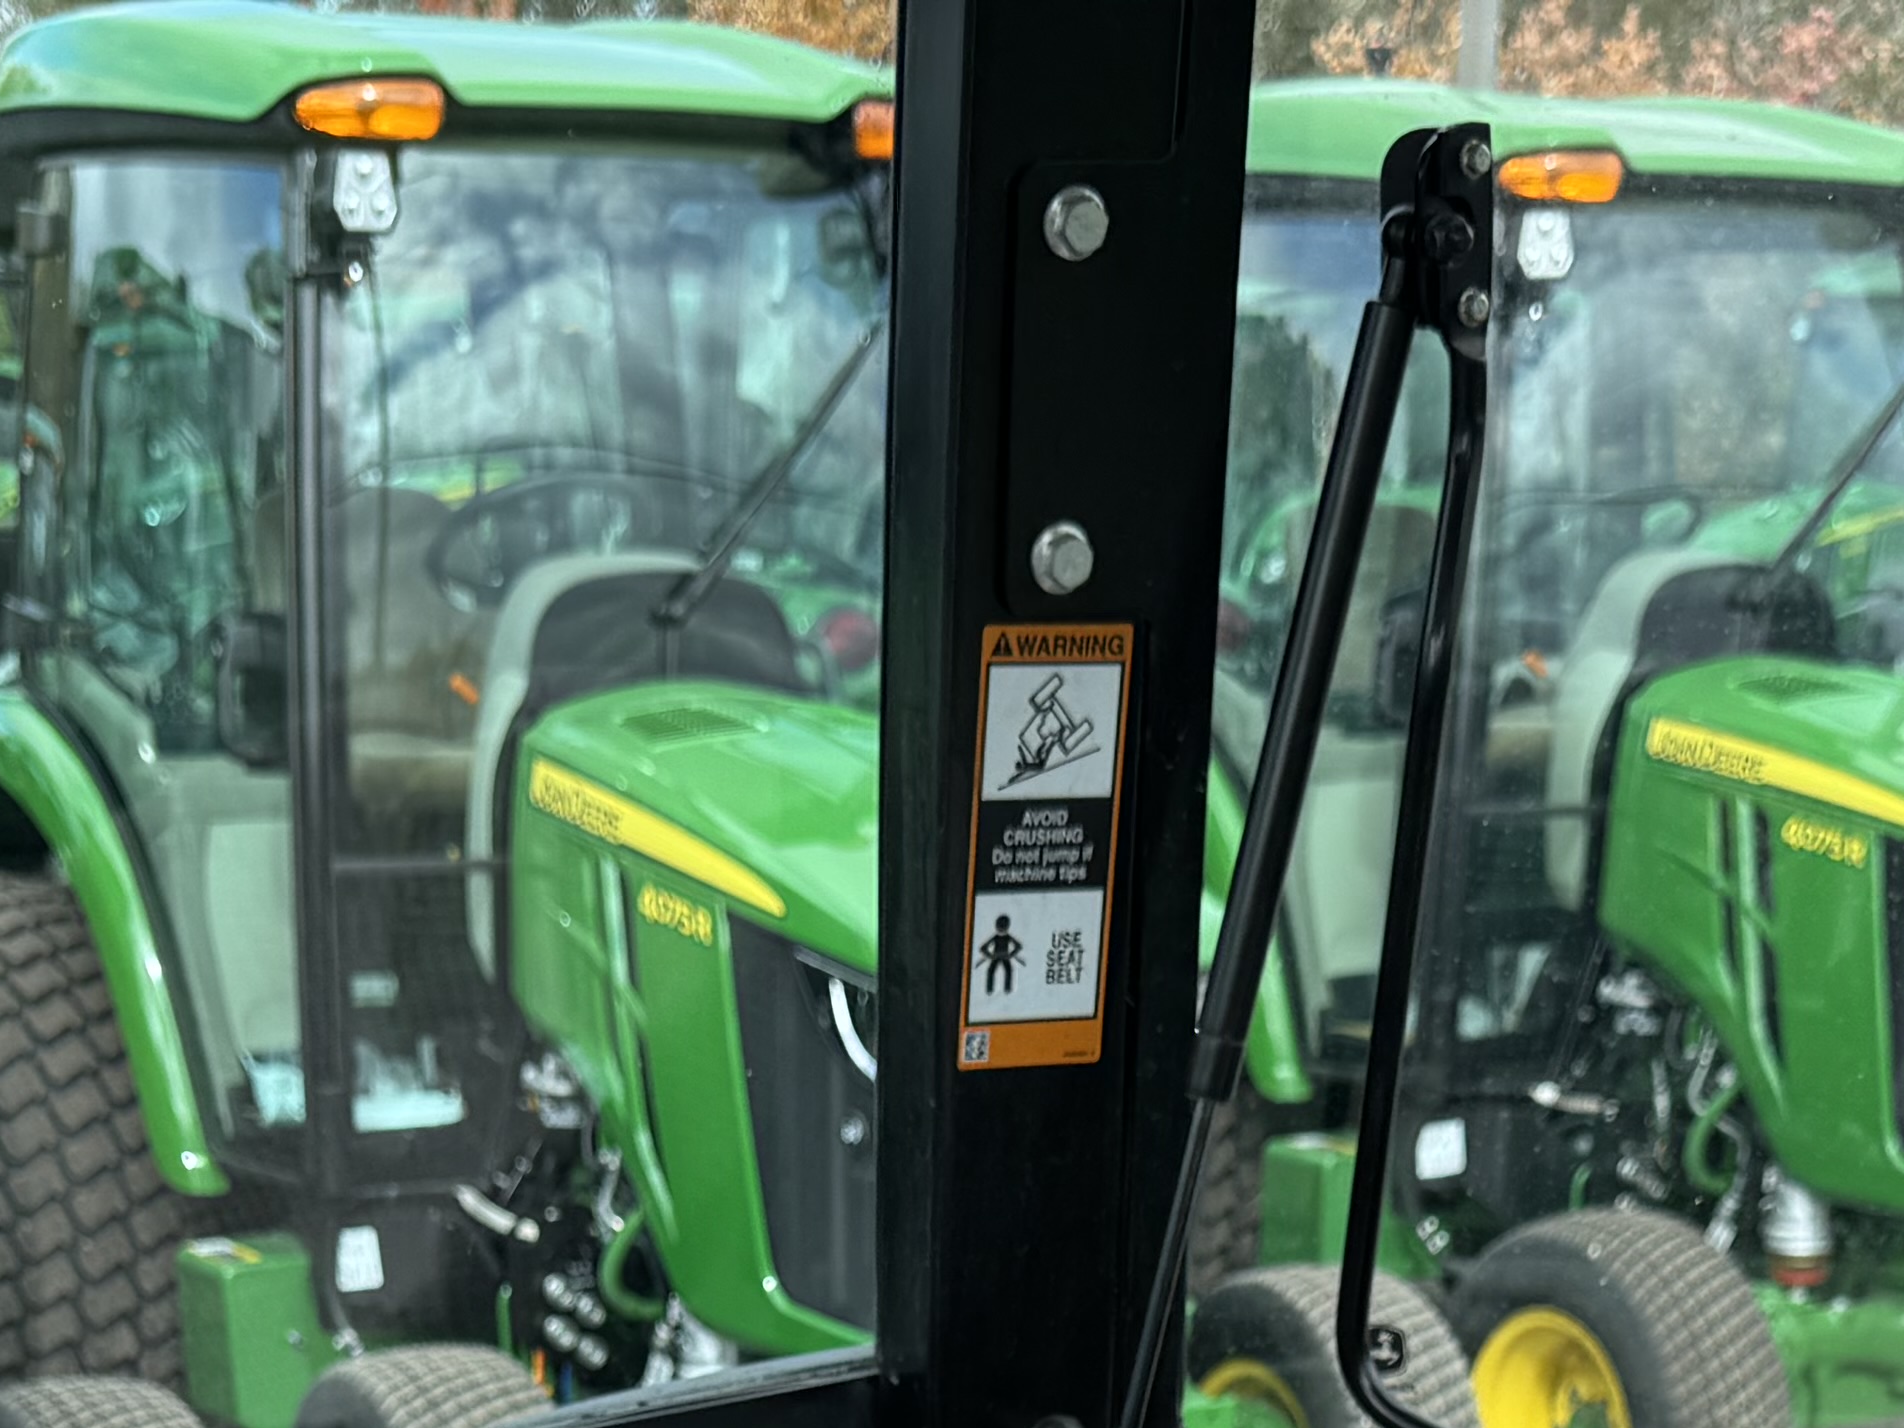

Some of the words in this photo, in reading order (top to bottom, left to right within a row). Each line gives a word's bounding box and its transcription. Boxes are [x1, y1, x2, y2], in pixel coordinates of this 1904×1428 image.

[1016, 635, 1124, 657] WARNING
[1022, 810, 1069, 828] AVOID
[1003, 826, 1084, 846] CRUSHING
[992, 848, 1013, 865] Do
[1015, 846, 1040, 864] not
[1042, 846, 1080, 867] jump
[995, 866, 1056, 883] machine
[1059, 864, 1087, 884] tips
[1051, 931, 1082, 949] USE
[1046, 950, 1084, 967] SEAT
[1046, 967, 1083, 984] BELT
